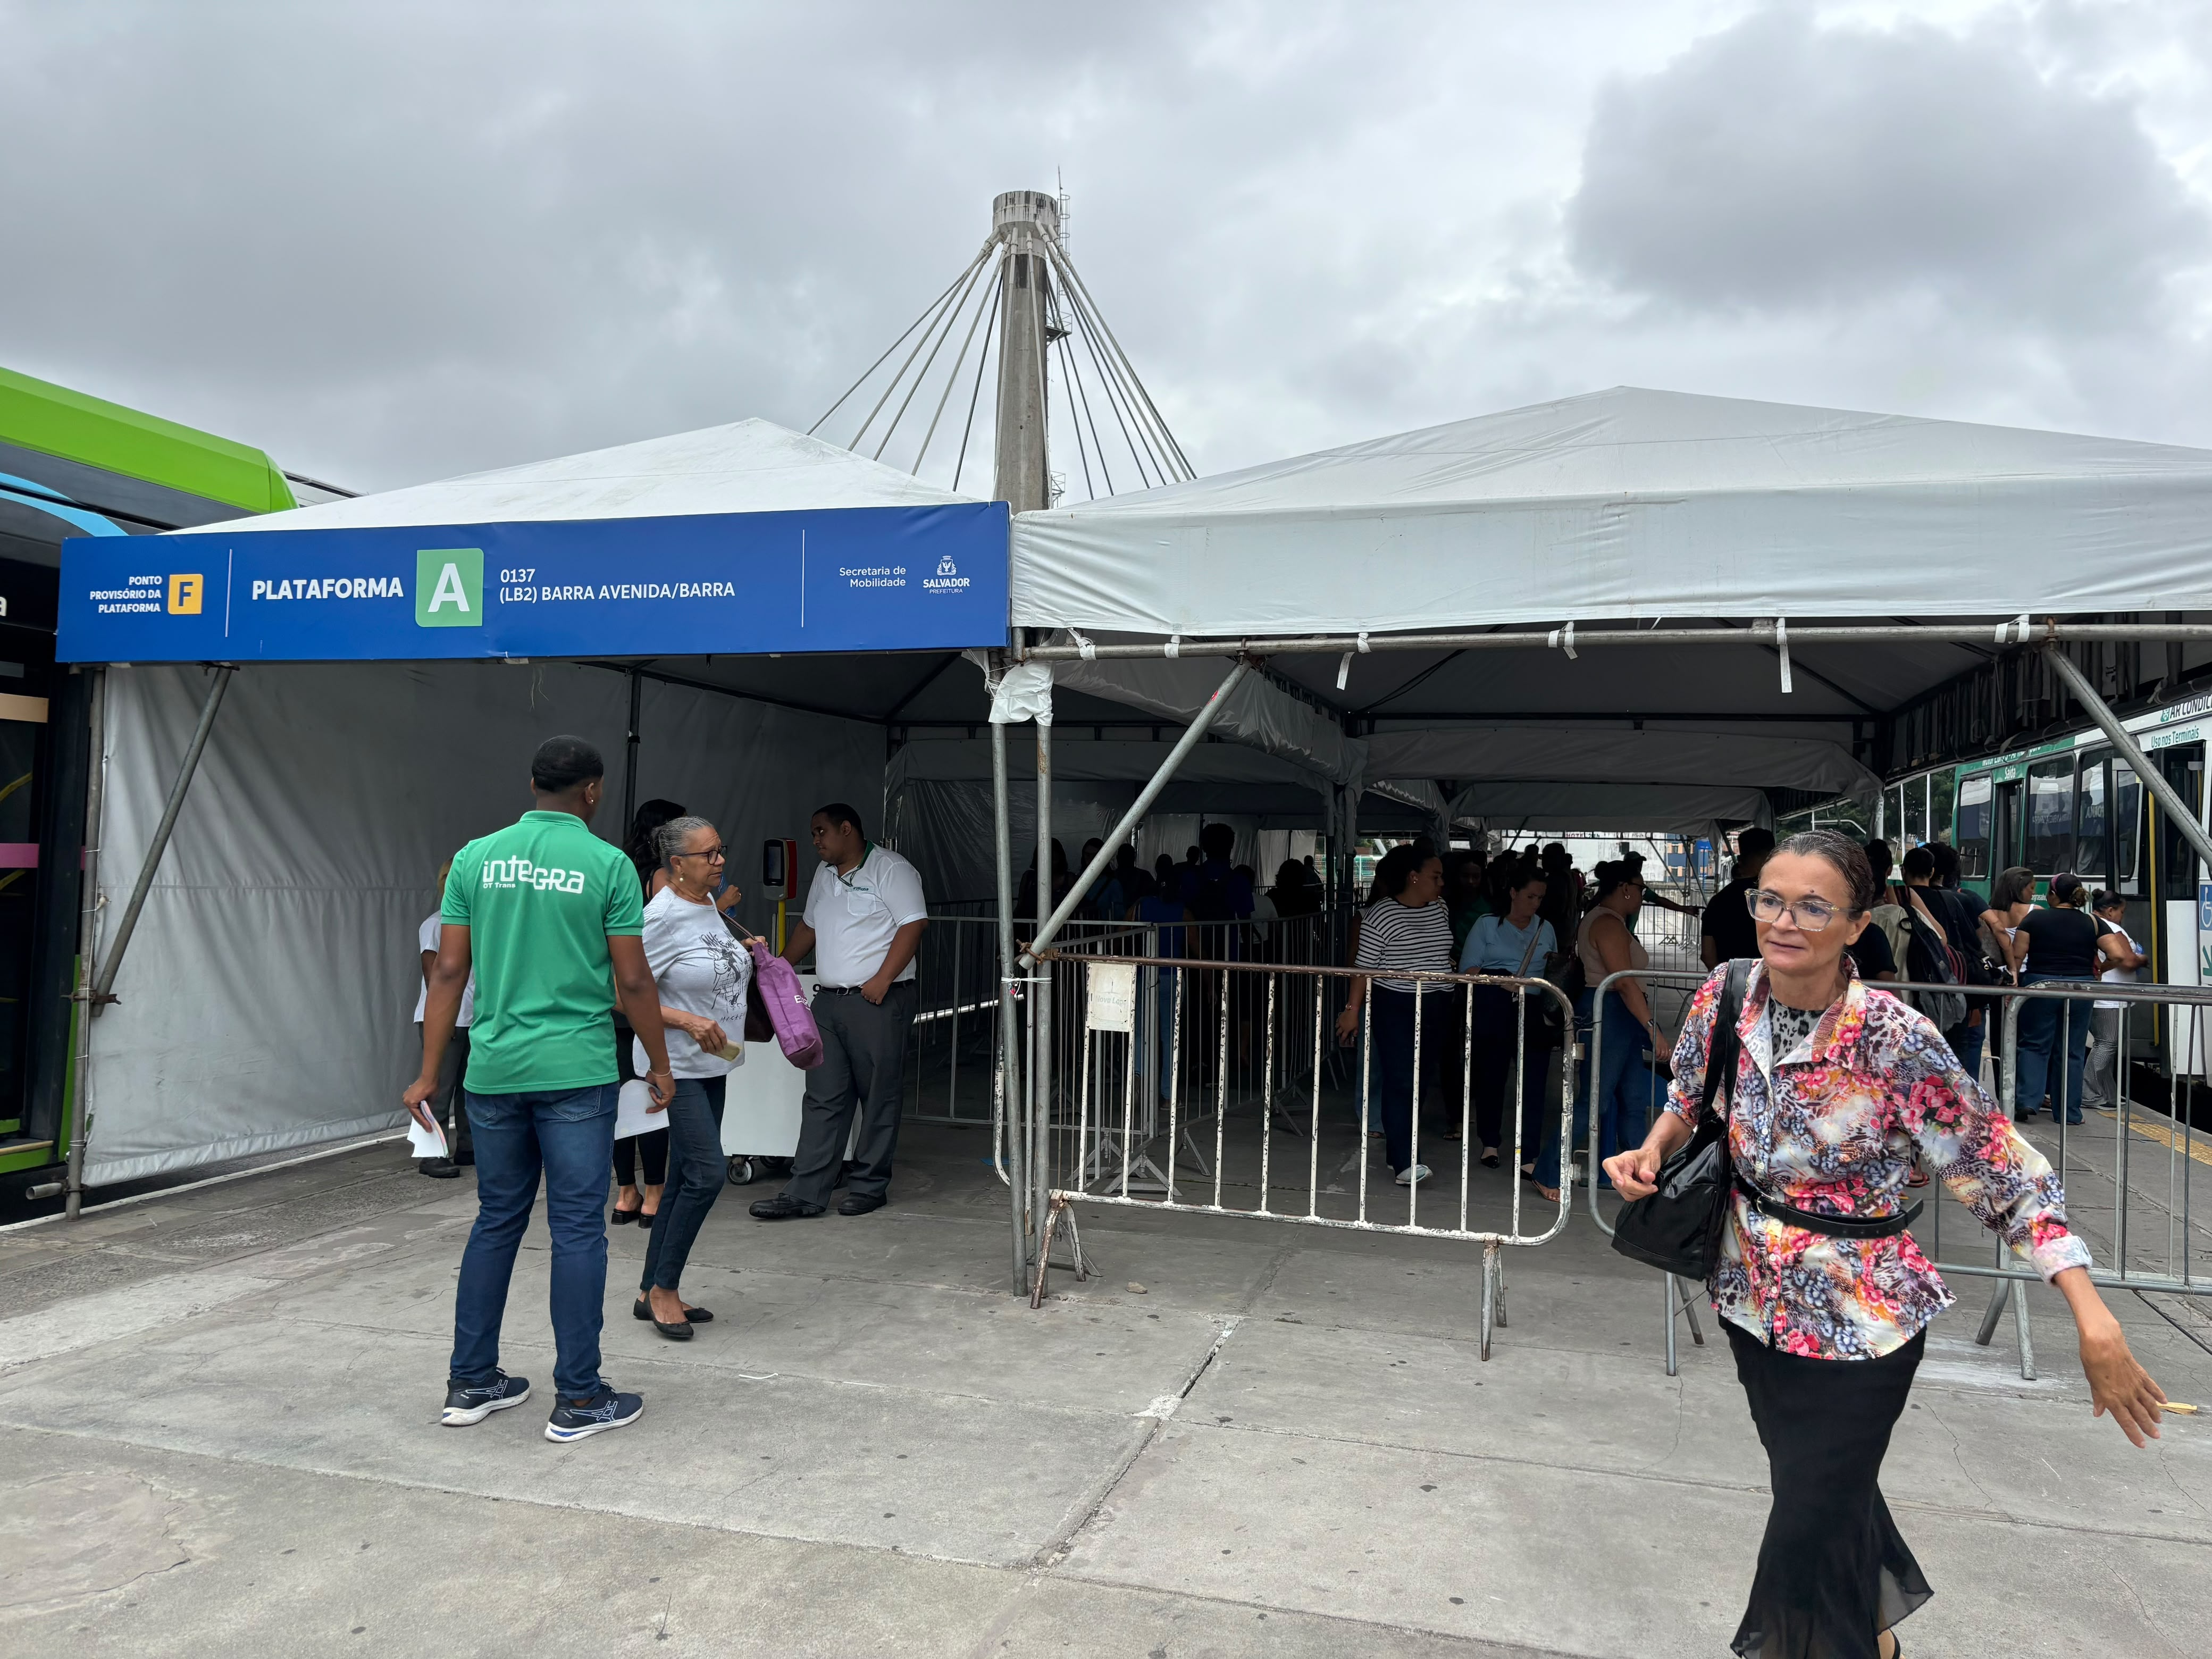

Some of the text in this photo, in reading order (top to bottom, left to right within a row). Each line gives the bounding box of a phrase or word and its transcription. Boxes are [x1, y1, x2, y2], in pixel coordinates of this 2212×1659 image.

[500, 568, 535, 583] 0137
[840, 566, 906, 576] Secretaria de
[129, 575, 162, 585] PONTO
[850, 577, 906, 588] Mobilidade
[923, 577, 970, 588] SALVADOR
[90, 588, 162, 600] PROVISÓRIO DA
[178, 581, 193, 607] F
[252, 577, 404, 600] PLATAFORMA
[428, 563, 470, 613] A
[500, 582, 735, 604] (LB2) BARRA AVENIDA/BARRA
[98, 603, 161, 613] PLATAFORMA
[2169, 704, 2181, 719] AR
[2151, 725, 2199, 748] Uso nos Terminais
[2005, 765, 2016, 780] Saída
[1112, 996, 1125, 1006] Lap
